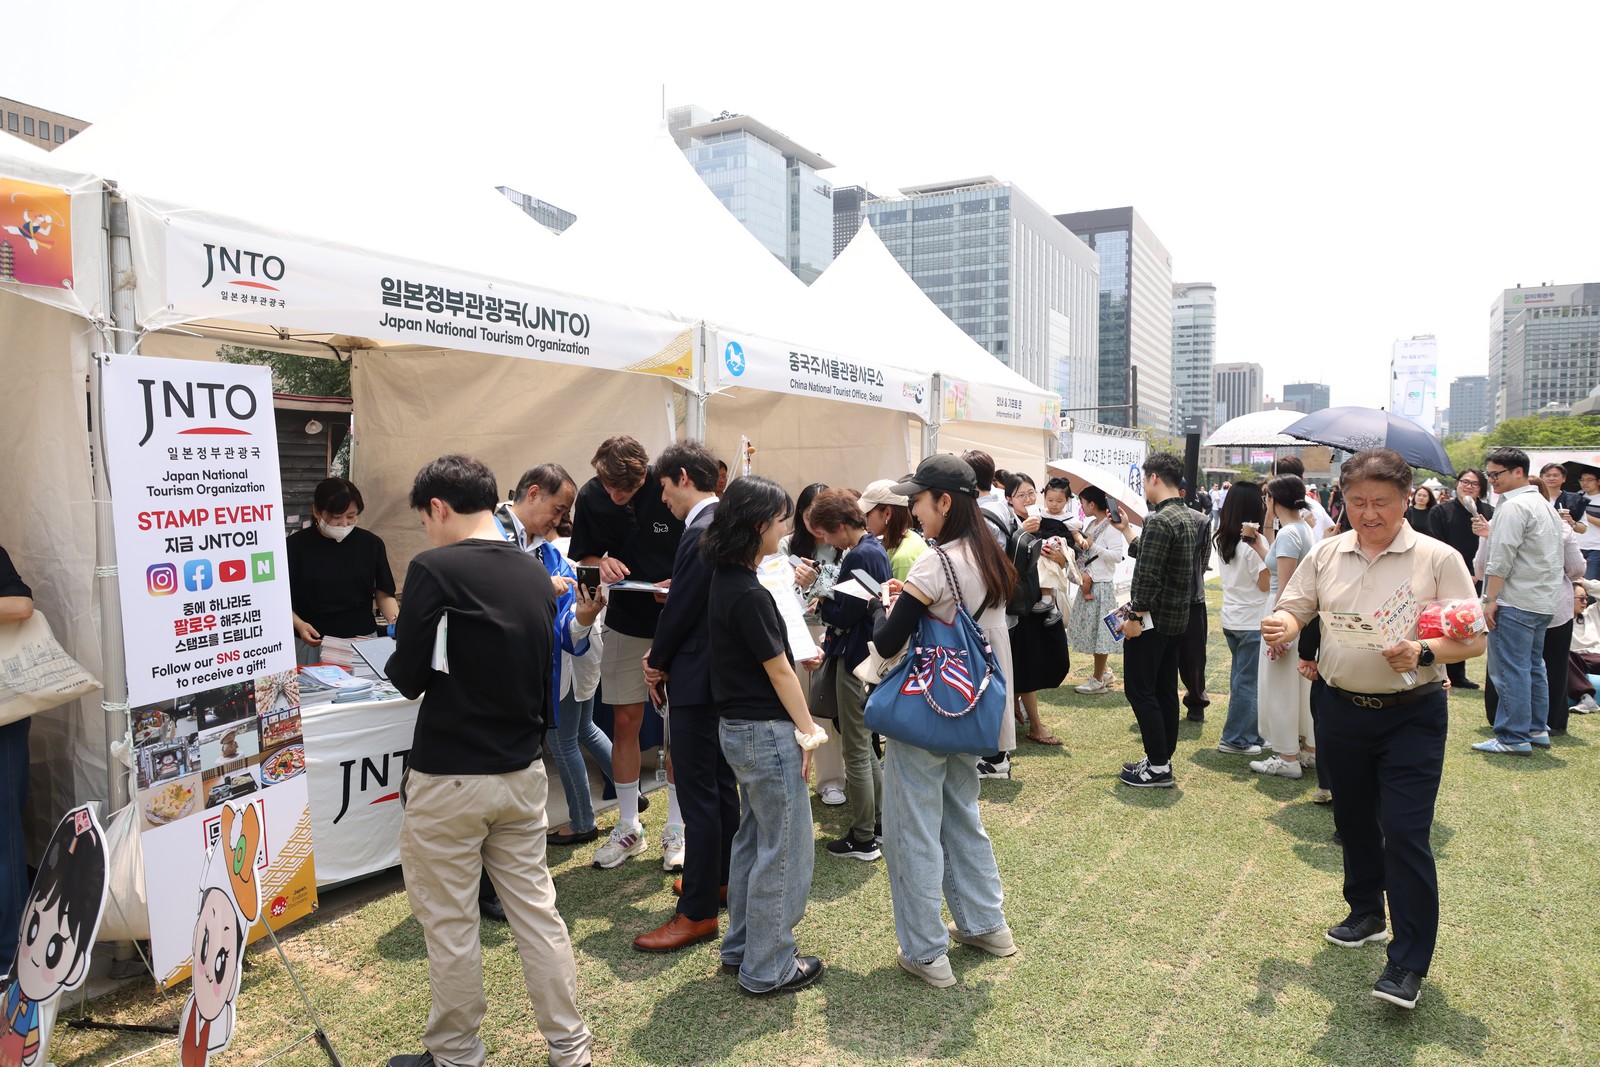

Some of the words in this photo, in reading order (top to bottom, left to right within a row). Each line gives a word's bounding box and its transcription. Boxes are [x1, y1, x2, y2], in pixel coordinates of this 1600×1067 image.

[202, 243, 285, 288] JNTO
[221, 291, 286, 308] 일본정부관광국
[381, 277, 590, 338] 일본정부관광국(JNTO)
[379, 312, 422, 332] Japan
[426, 319, 477, 339] National
[480, 327, 523, 345] Tourism
[526, 334, 590, 355] Organization
[789, 351, 884, 387] 중국주서울관광사무소
[790, 378, 807, 390] China
[808, 381, 831, 394] National
[832, 385, 851, 397] Tourist
[852, 389, 868, 402] Office,
[869, 392, 883, 402] Seoul
[137, 379, 257, 447] JNTO
[167, 446, 261, 460] 일본정부관광국
[1083, 449, 1099, 463] 2025
[146, 485, 193, 497] Tourism
[196, 482, 265, 497] Organization
[162, 470, 200, 484] Japan
[202, 469, 248, 481] National
[137, 508, 209, 531] STAMP
[214, 504, 274, 525] EVENT
[165, 535, 194, 554] 지금
[199, 530, 258, 551] JNTO의
[183, 601, 206, 616] 중에
[209, 594, 252, 612] 하나라도
[1386, 613, 1398, 625] TCS
[1397, 600, 1409, 613] DAY
[174, 614, 217, 636] 팔로우
[220, 609, 261, 628] 해주시면
[175, 633, 220, 653] 스탬프를
[223, 625, 263, 644] 드립니다
[151, 660, 191, 679] Follow
[194, 657, 214, 669] our
[216, 650, 241, 665] SNS
[243, 641, 283, 659] account
[176, 677, 189, 689] to
[191, 667, 234, 686] receive
[236, 665, 244, 675] a
[246, 658, 267, 676] gift!
[333, 749, 412, 825] JNT
